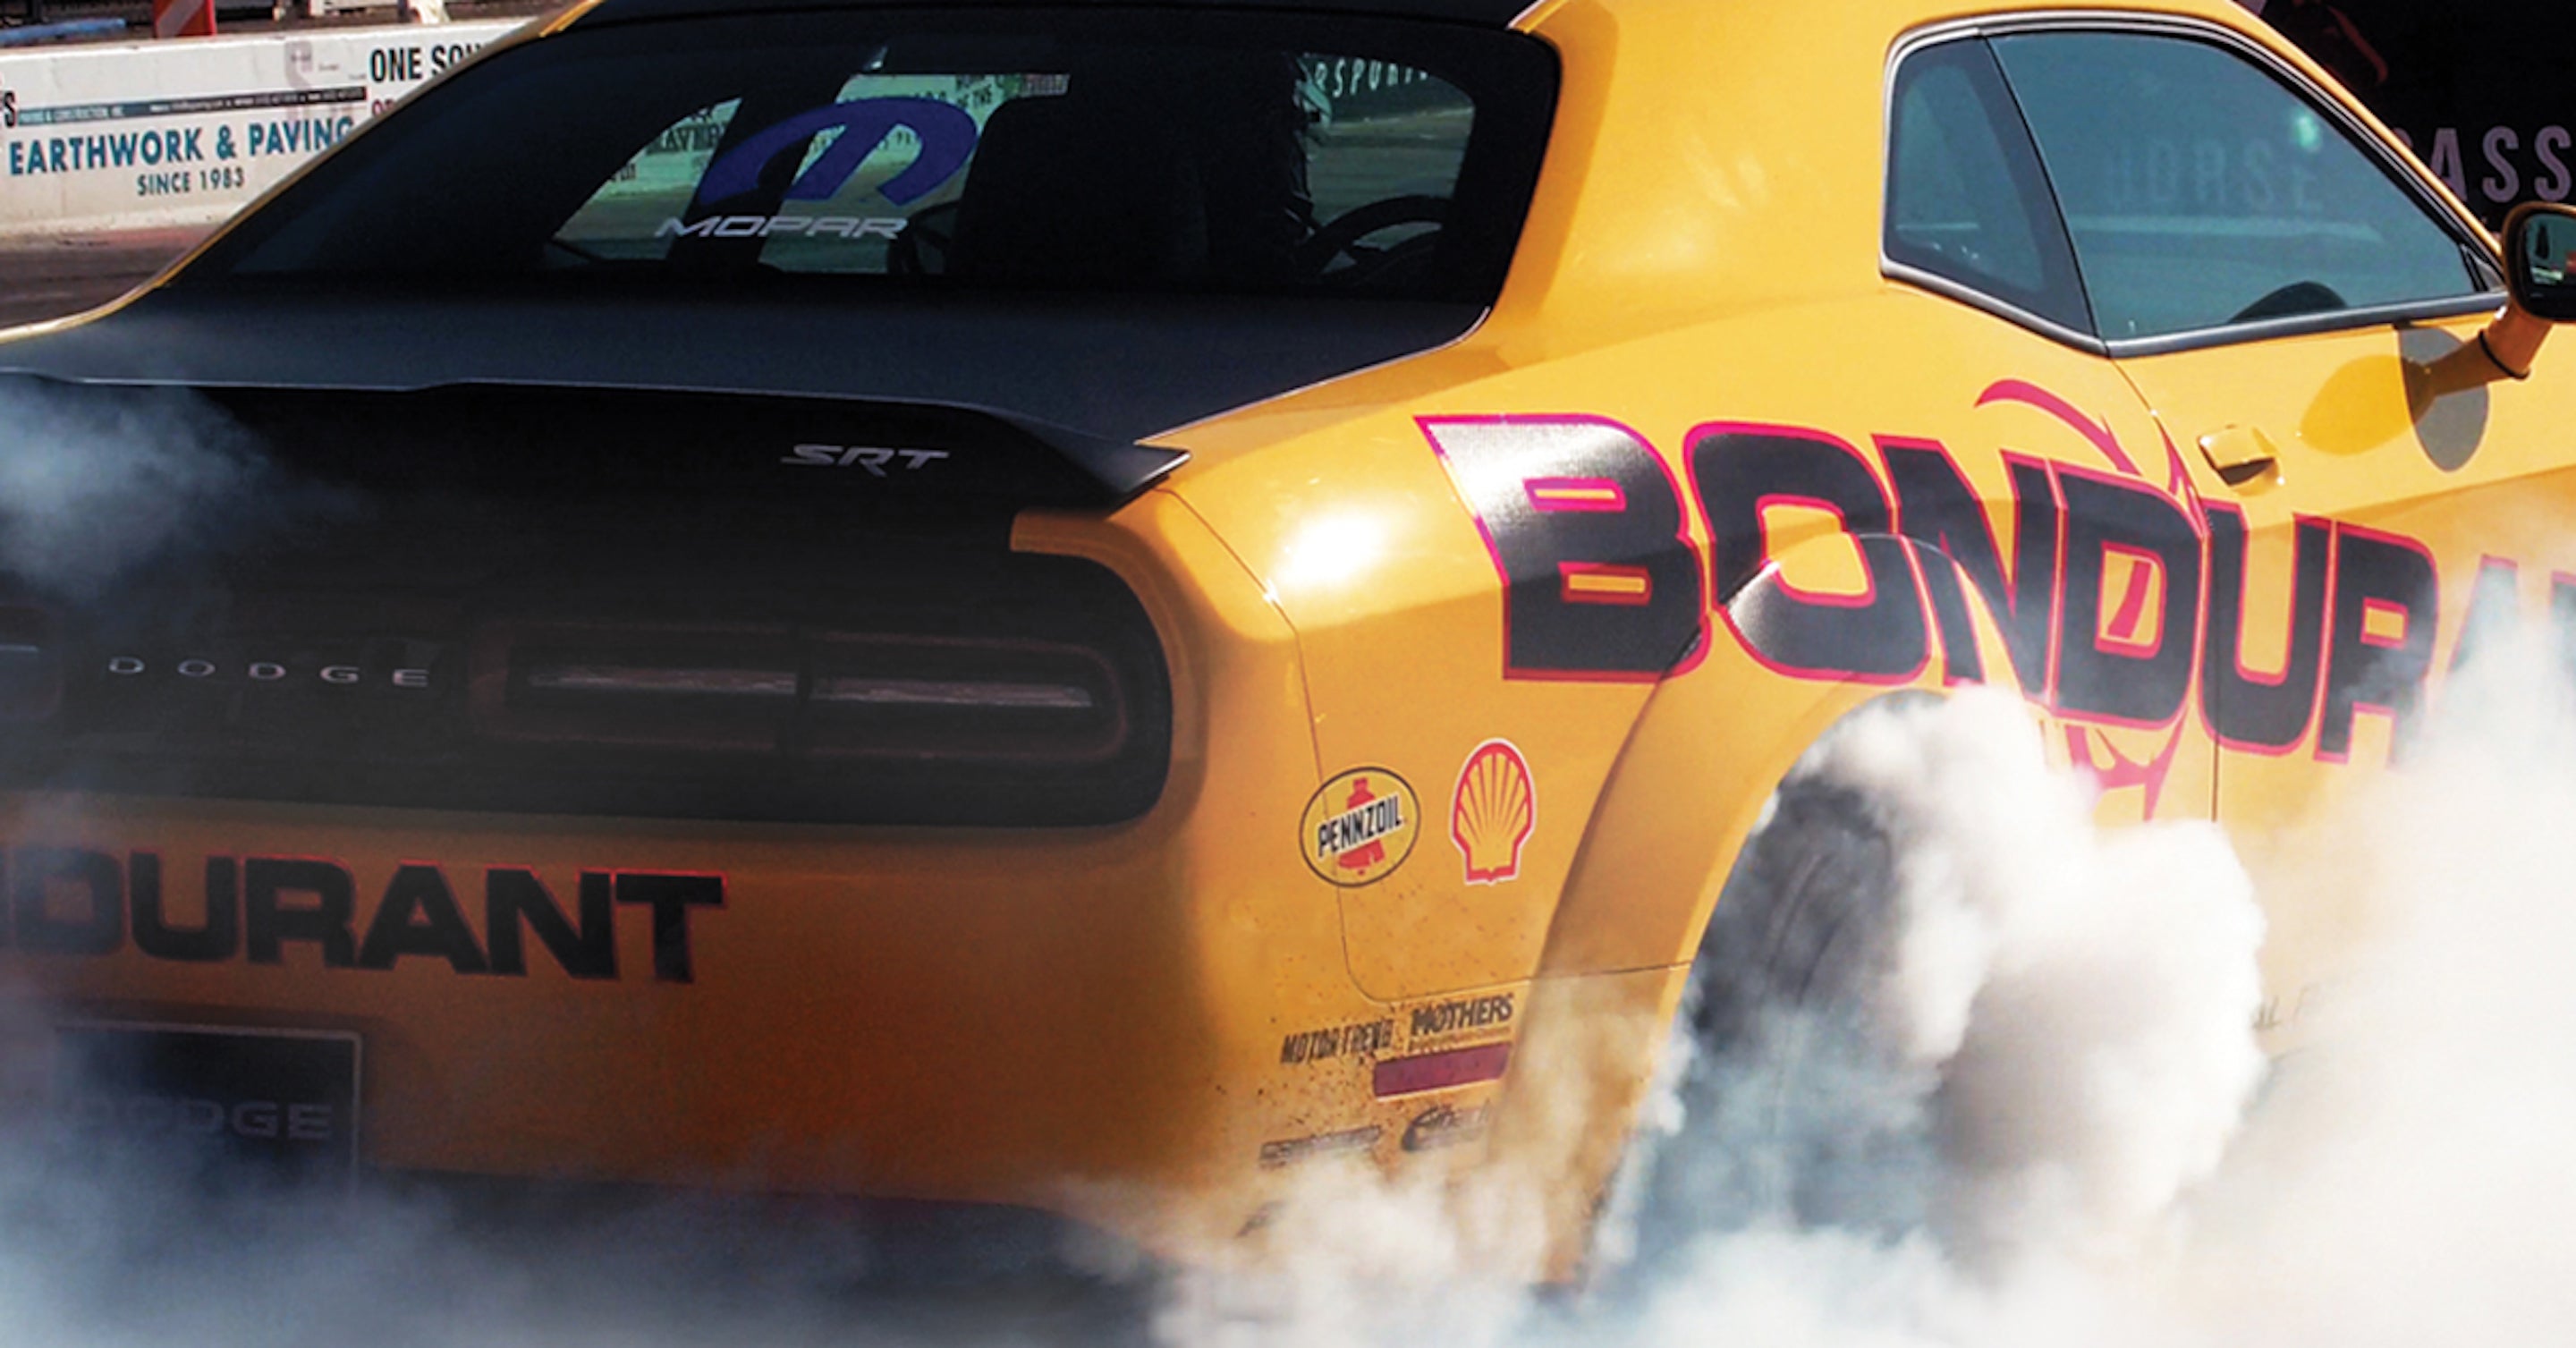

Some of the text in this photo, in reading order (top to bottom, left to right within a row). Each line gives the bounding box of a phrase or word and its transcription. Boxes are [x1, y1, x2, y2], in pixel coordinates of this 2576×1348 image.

[370, 43, 484, 82] ONE SO
[9, 127, 204, 175] EARTHWORK
[216, 124, 237, 161] &
[2394, 124, 2573, 203] ASS
[137, 167, 245, 197] SINCE 1983
[654, 216, 909, 240] MOPAR
[780, 444, 950, 478] SRT
[108, 657, 430, 688] DODGE
[1318, 794, 1402, 858] PENNZOIL
[0, 844, 727, 984] DURANT
[1411, 996, 1513, 1036] MOTHERS
